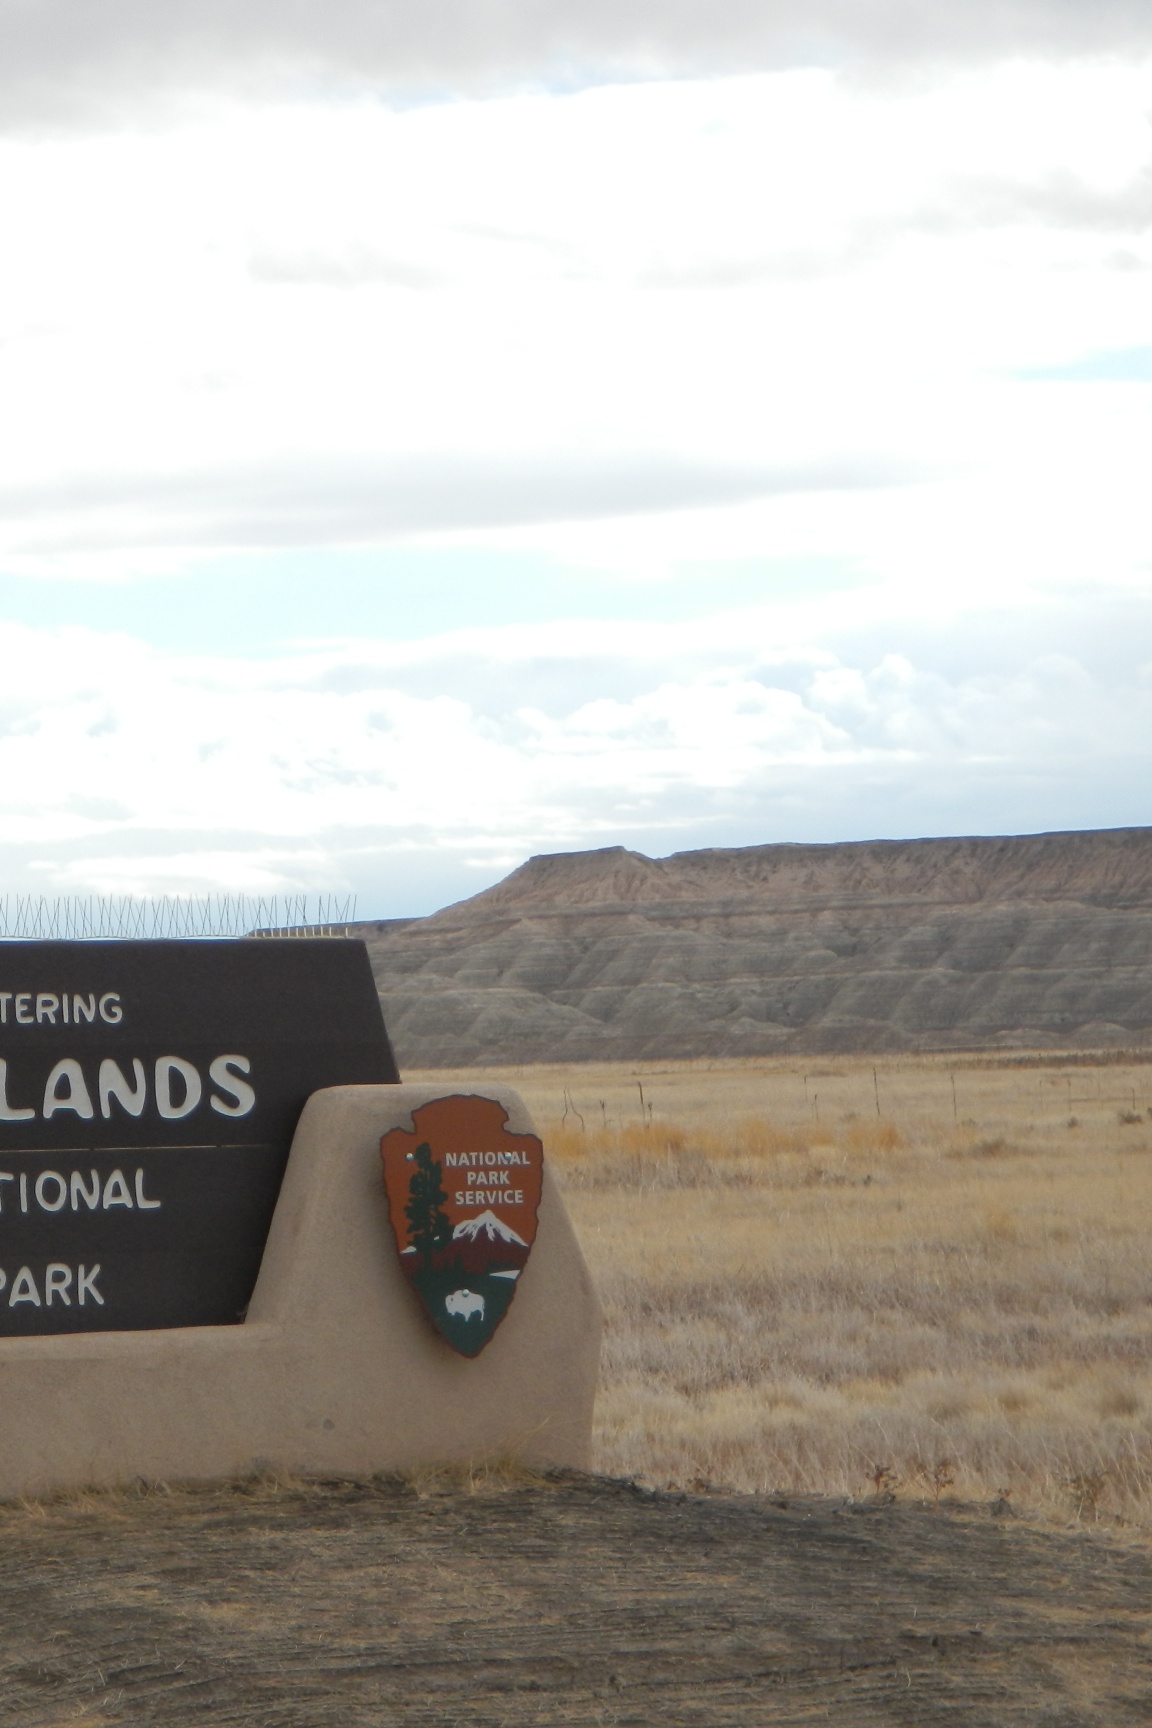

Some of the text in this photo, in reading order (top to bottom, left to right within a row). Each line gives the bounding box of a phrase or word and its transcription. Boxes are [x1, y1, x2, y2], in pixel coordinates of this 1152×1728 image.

[445, 1151, 531, 1167] NATIONAL
[467, 1171, 510, 1185] PARK
[455, 1190, 524, 1205] SERVICE
